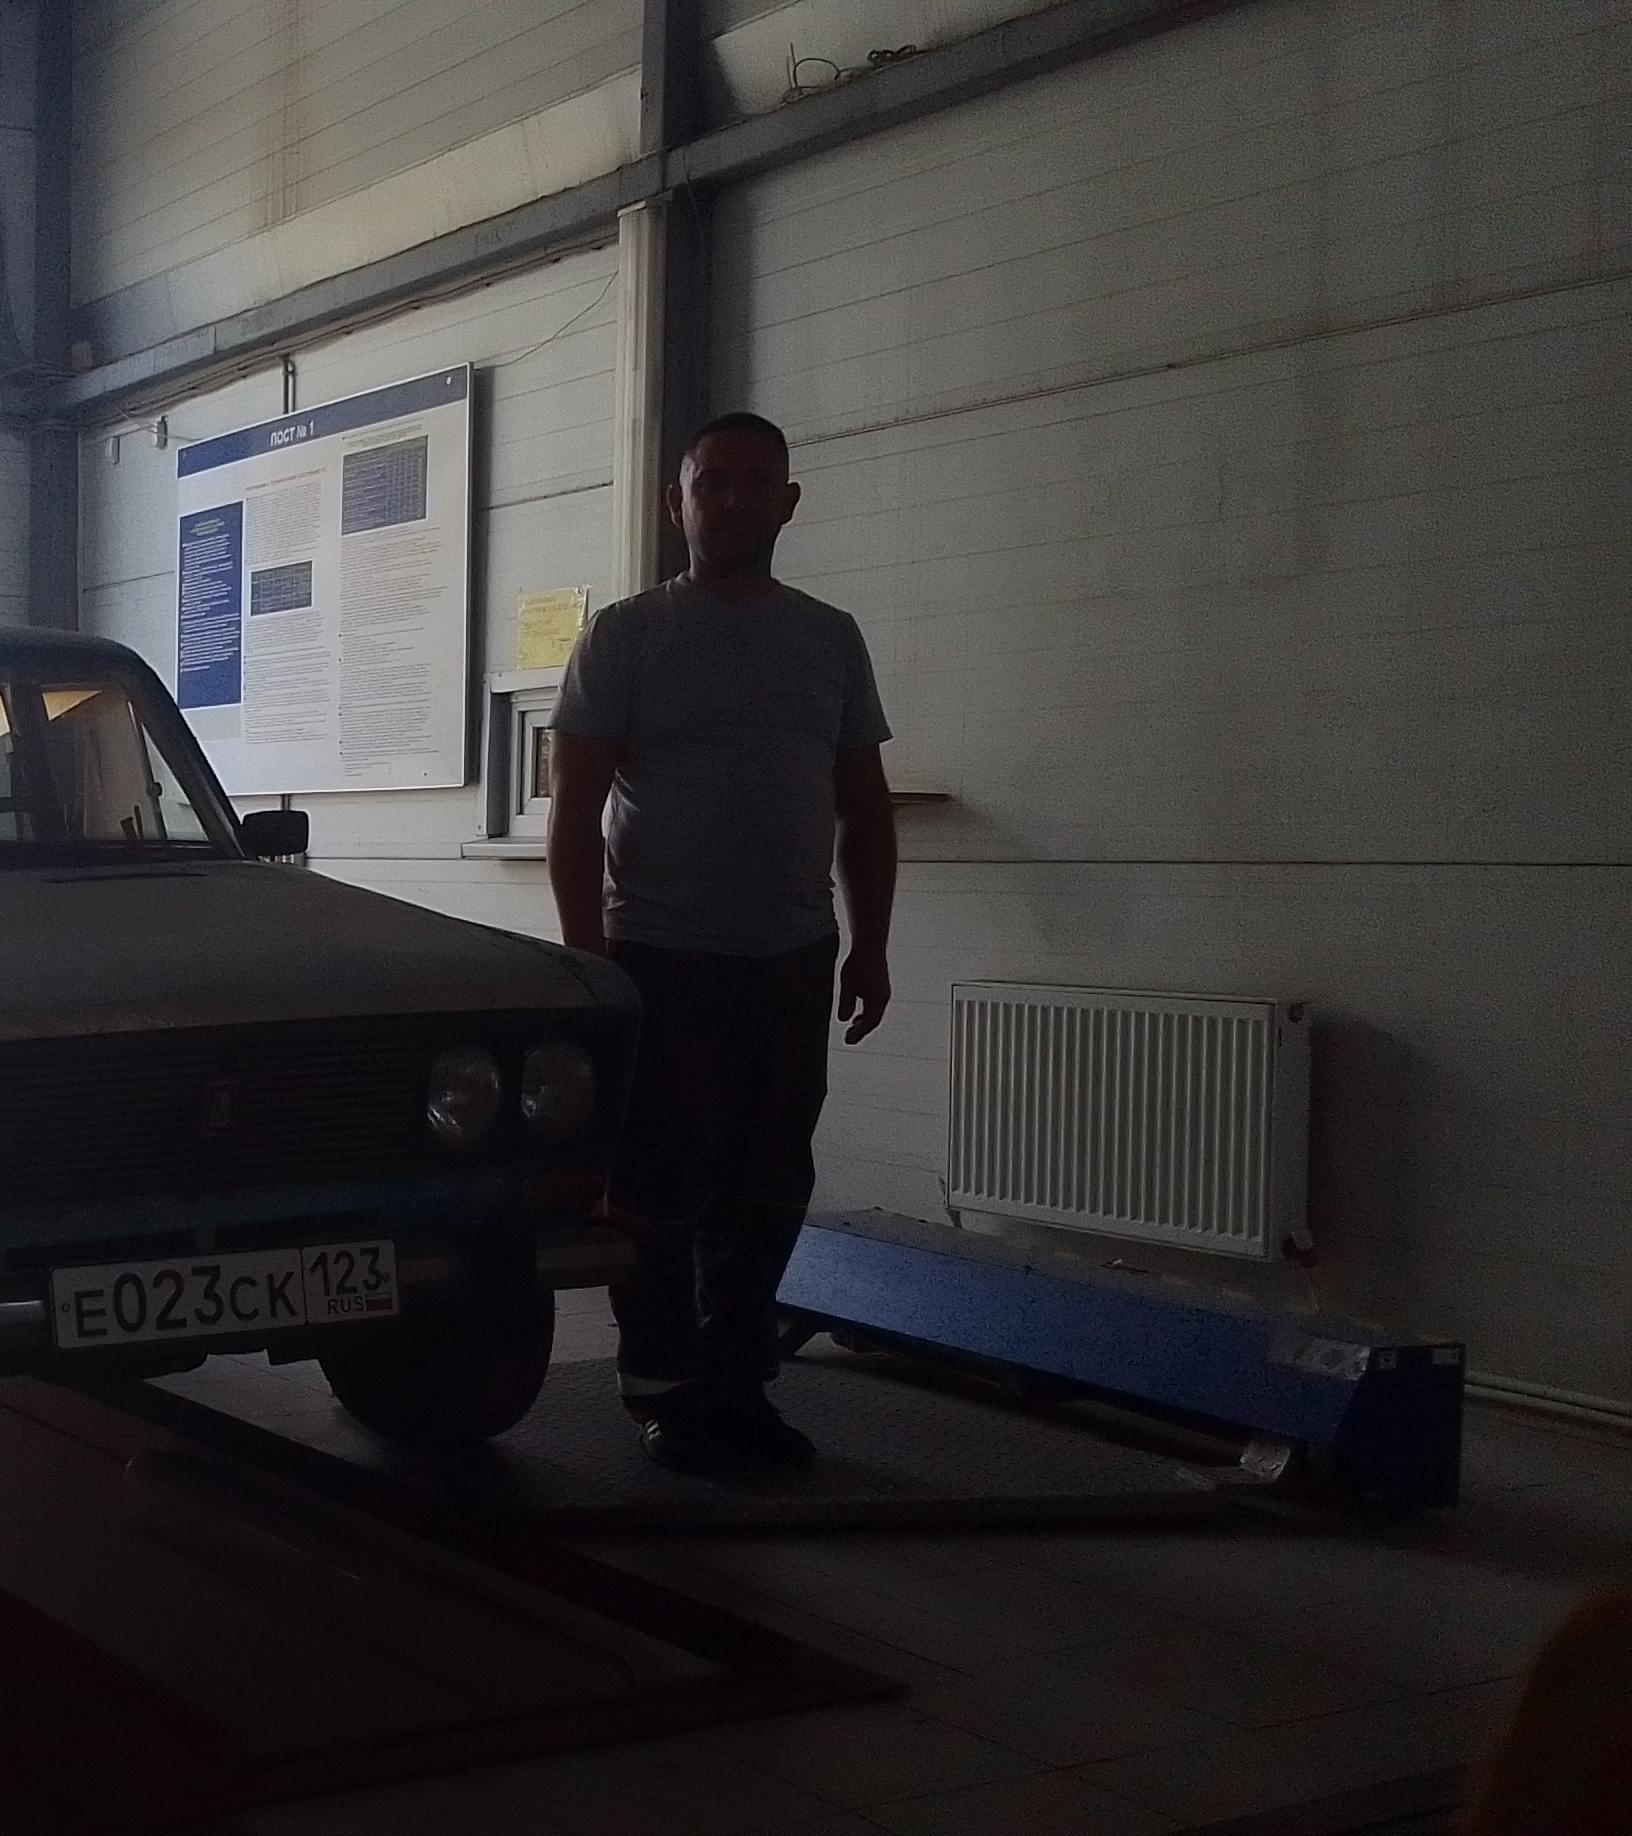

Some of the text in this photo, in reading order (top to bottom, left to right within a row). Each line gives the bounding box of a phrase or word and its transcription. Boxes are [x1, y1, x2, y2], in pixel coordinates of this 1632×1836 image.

[270, 427, 296, 447] ПОСТ
[309, 420, 314, 436] 1
[309, 1246, 380, 1297] 123
[328, 1296, 365, 1315] RUS
